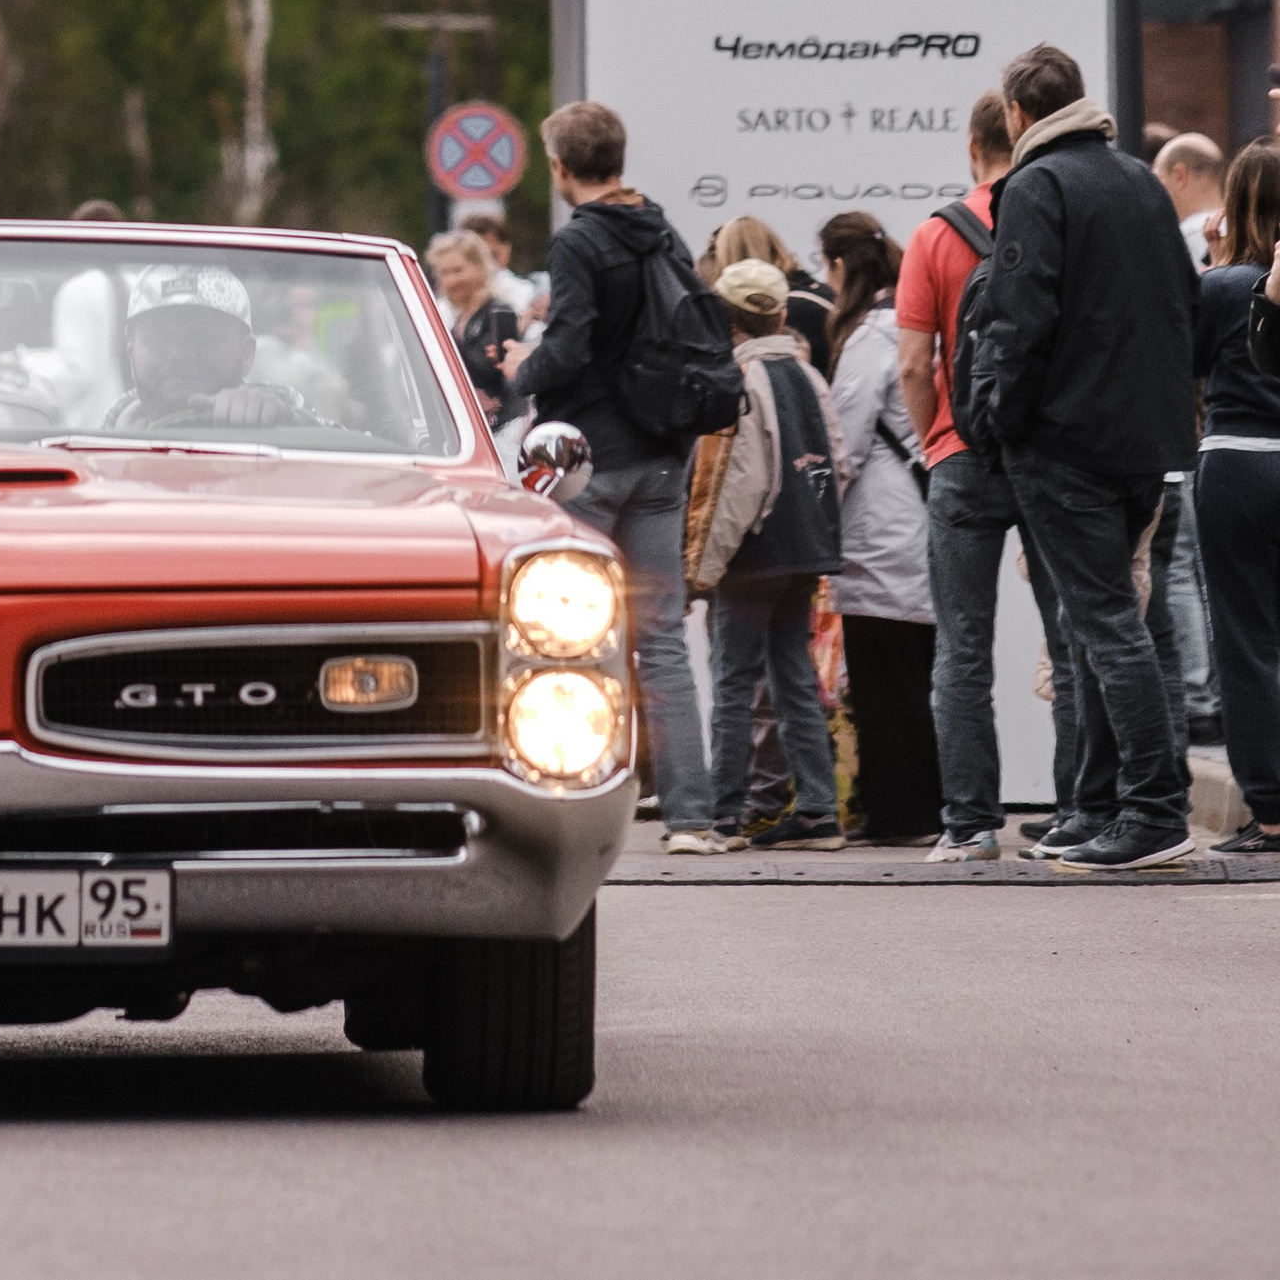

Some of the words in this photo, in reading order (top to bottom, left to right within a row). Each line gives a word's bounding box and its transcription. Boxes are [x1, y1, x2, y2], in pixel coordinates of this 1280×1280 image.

[737, 107, 831, 133] SARTO
[870, 107, 958, 133] REALE
[121, 682, 277, 707] GTO
[90, 878, 147, 920] 95
[85, 923, 127, 939] RUS
